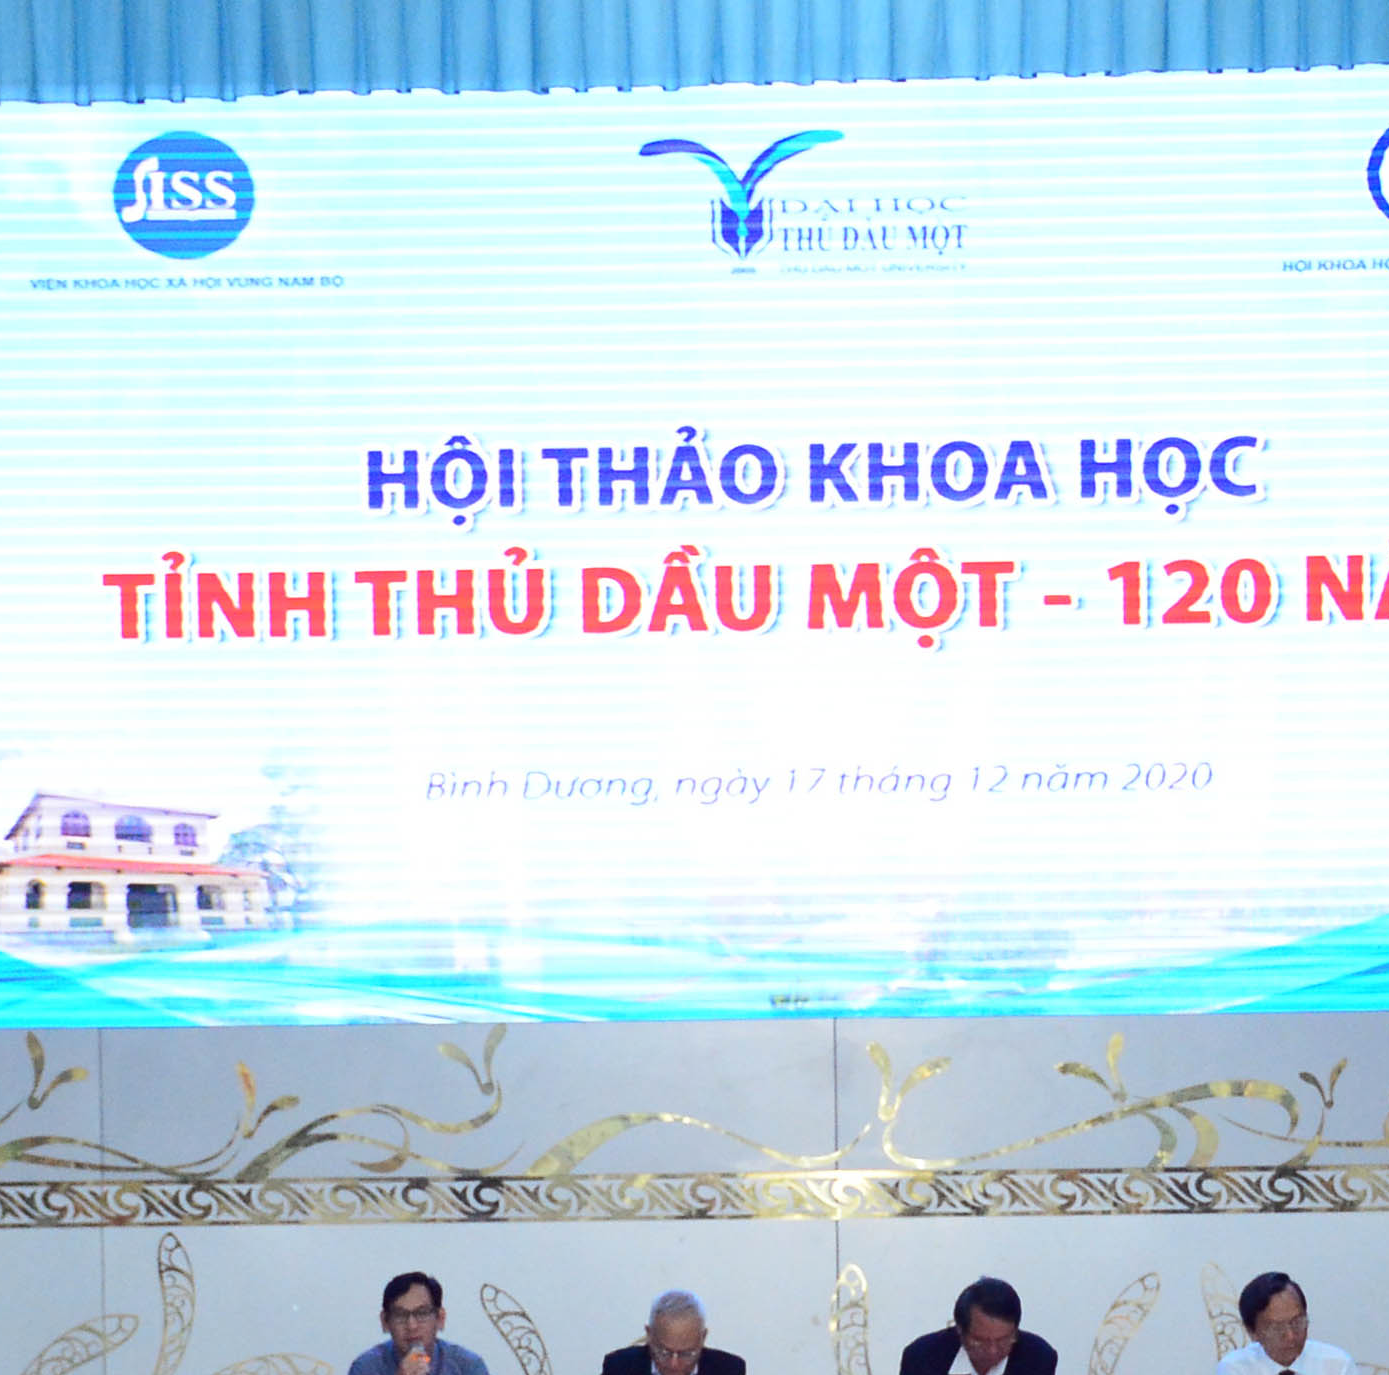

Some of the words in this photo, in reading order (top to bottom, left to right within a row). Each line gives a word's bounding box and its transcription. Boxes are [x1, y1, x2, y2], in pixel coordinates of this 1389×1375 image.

[906, 218, 969, 256] MỘT
[72, 277, 121, 290] KHOA
[277, 275, 315, 288] NAM
[1316, 258, 1368, 272] KHOA
[368, 435, 516, 526] HỘI
[542, 425, 777, 506] THẢO
[809, 440, 1048, 502] KHOA
[1080, 436, 1260, 515] HỌC
[102, 551, 326, 639] TỈNH
[354, 546, 544, 636] THỦ
[581, 544, 771, 634] DẦU
[807, 547, 1014, 648] MỘT
[1043, 594, 1072, 606] -
[1107, 558, 1271, 625] 120
[675, 767, 771, 805] ngày
[789, 767, 826, 793] 17
[839, 765, 952, 802] tháng
[972, 764, 1009, 793] 12
[1021, 763, 1109, 793] năm
[1121, 761, 1214, 792] 2020
